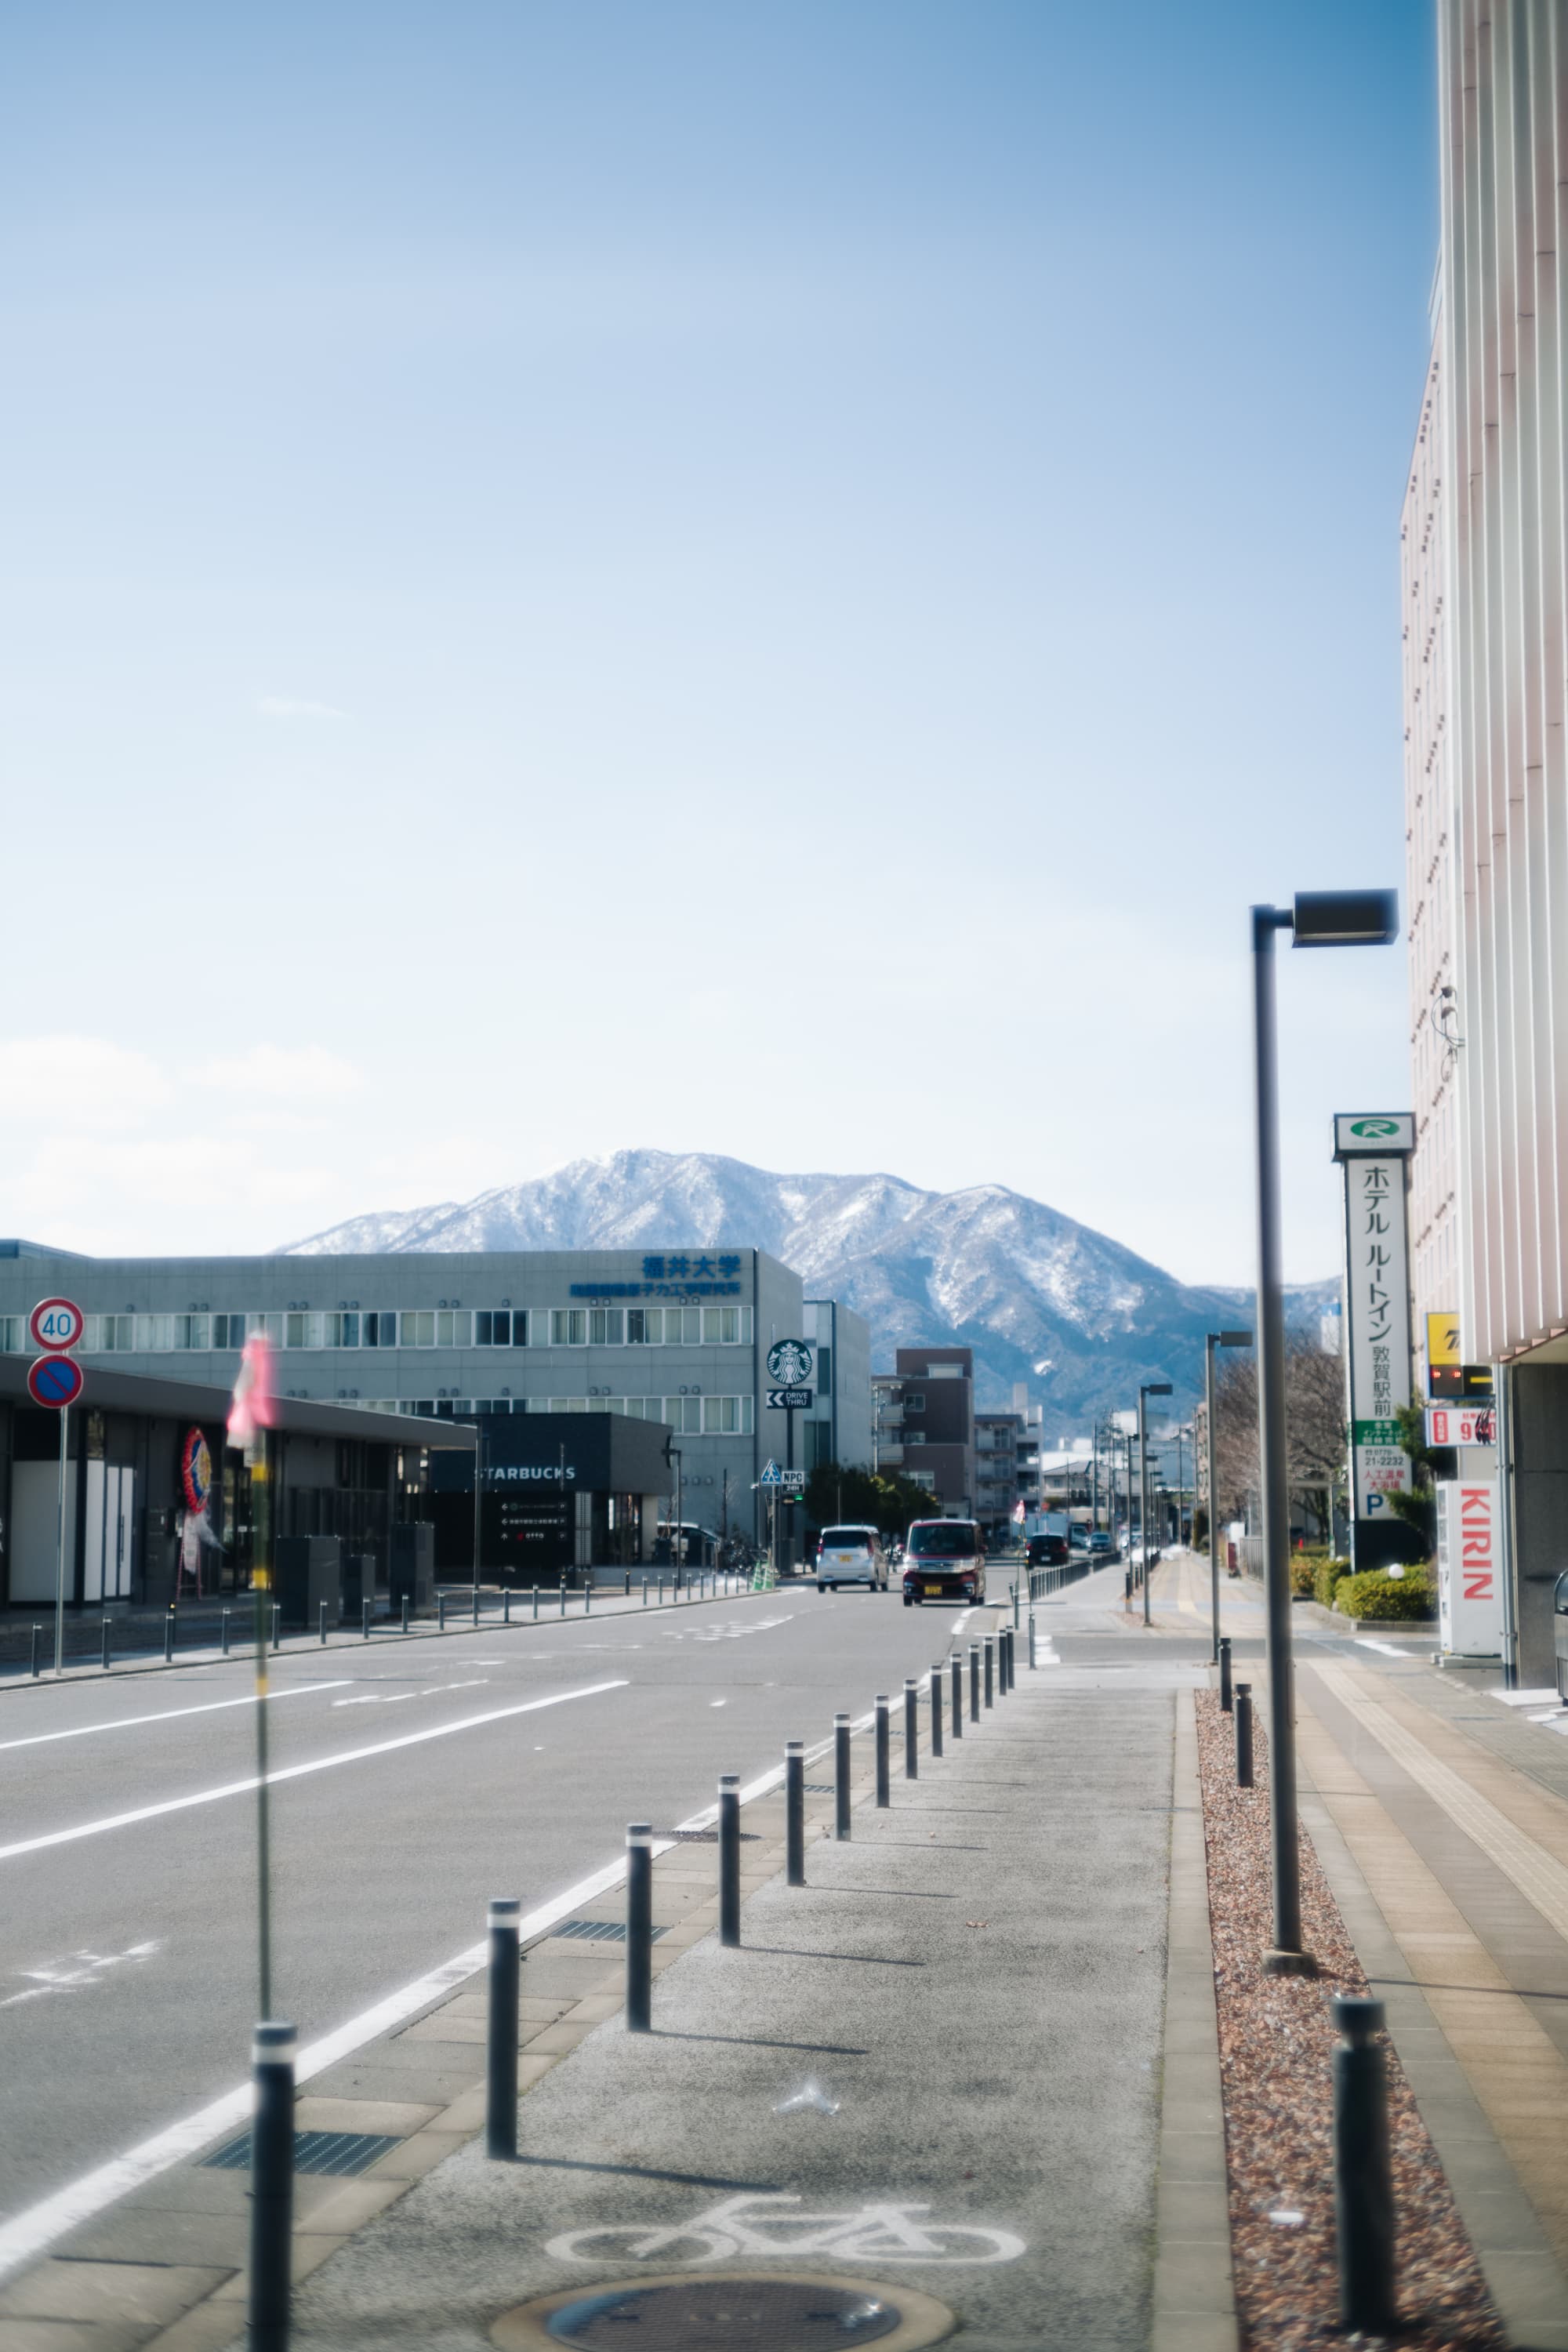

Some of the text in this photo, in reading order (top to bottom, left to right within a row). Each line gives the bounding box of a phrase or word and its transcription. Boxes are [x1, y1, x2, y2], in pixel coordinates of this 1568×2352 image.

[1363, 1167, 1390, 1235] ホテル
[643, 1255, 741, 1279] 福井大学
[1367, 1245, 1392, 1342] ルートイン
[42, 1313, 71, 1336] 40
[1373, 1345, 1392, 1417] 敦賀駅前
[1365, 1457, 1404, 1466] 21-2232
[784, 1472, 802, 1483] NPC
[1367, 1494, 1384, 1515] P
[1461, 1488, 1494, 1600] KIRIN
